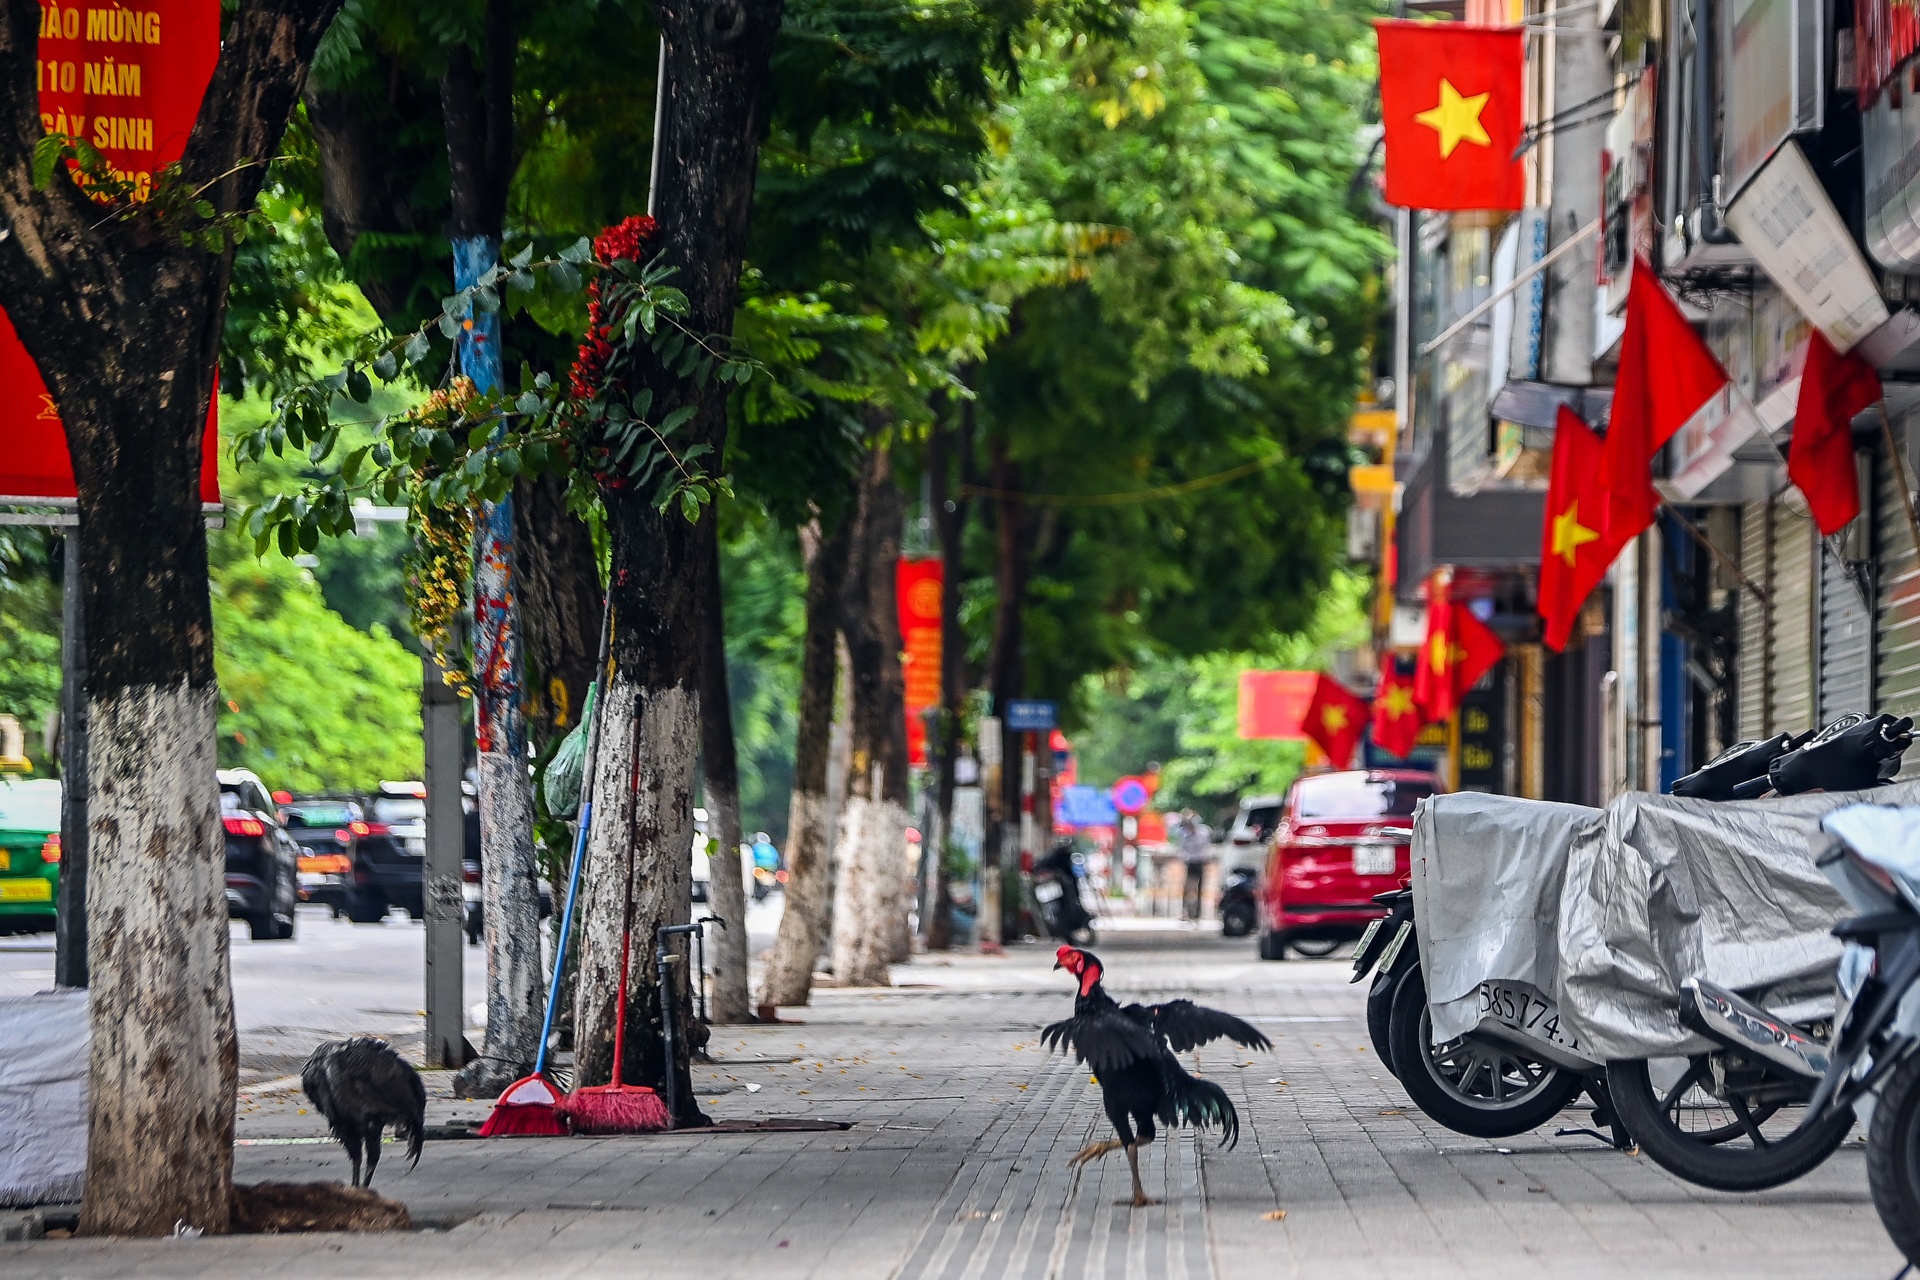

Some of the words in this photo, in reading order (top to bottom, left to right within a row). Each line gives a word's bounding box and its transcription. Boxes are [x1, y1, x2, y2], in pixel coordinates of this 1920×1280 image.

[86, 1, 161, 45] MỪNG
[37, 59, 77, 94] 110
[84, 56, 141, 97] NĂM
[93, 115, 153, 151] SINH
